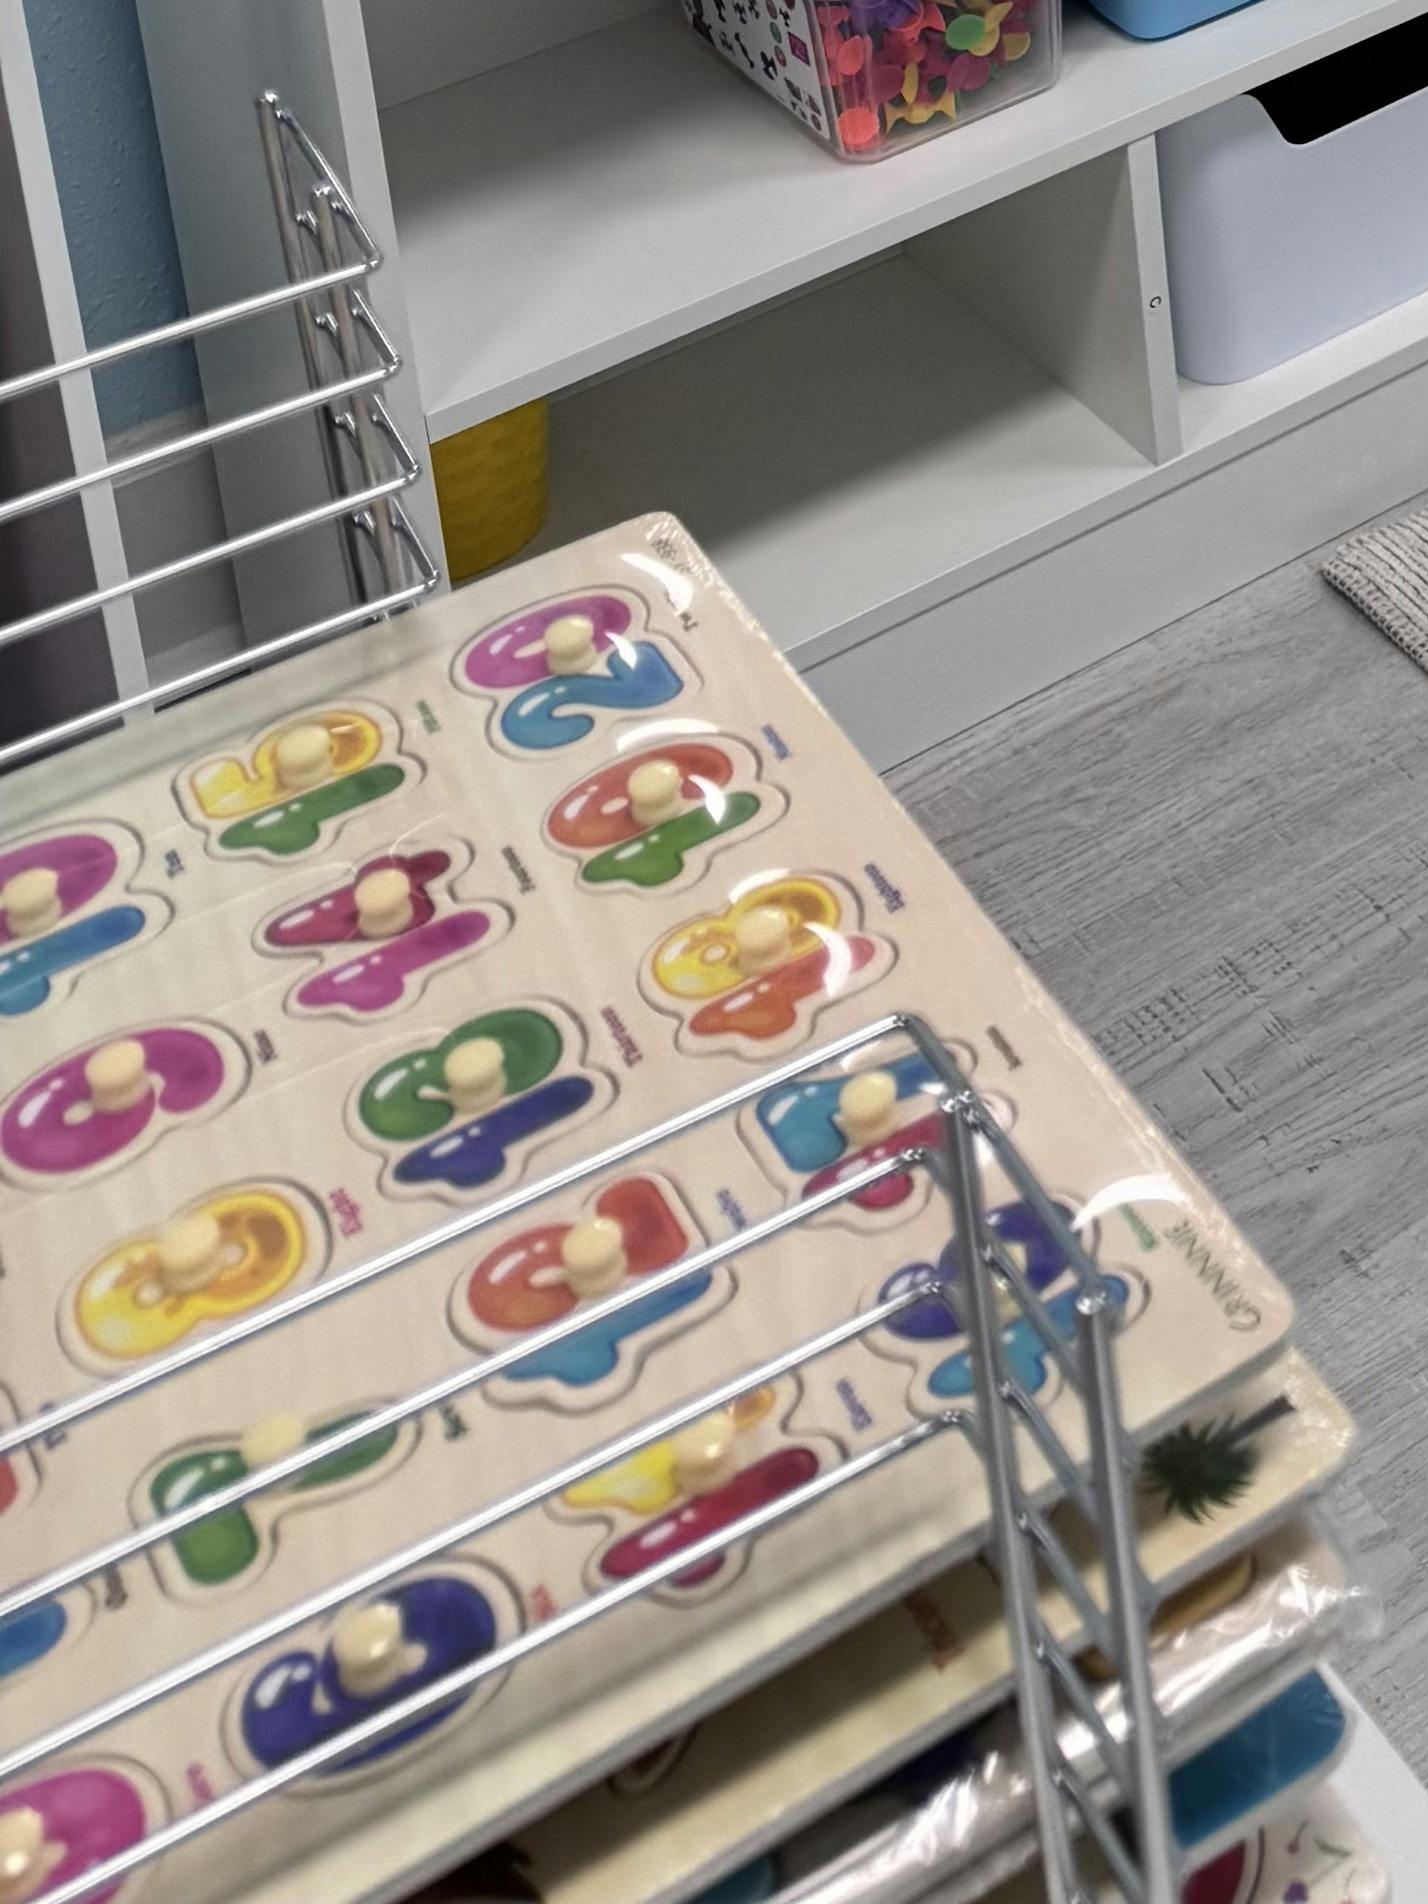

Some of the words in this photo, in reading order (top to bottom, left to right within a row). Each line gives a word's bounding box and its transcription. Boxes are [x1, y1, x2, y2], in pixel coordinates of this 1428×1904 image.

[466, 594, 683, 750] 20
[188, 709, 407, 855] 15
[547, 743, 761, 888] 19
[264, 849, 491, 1012] 14
[651, 876, 876, 1041] 18
[359, 1008, 594, 1188] 13
[600, 1005, 644, 1069] Thirteen
[329, 1187, 364, 1238] Eight
